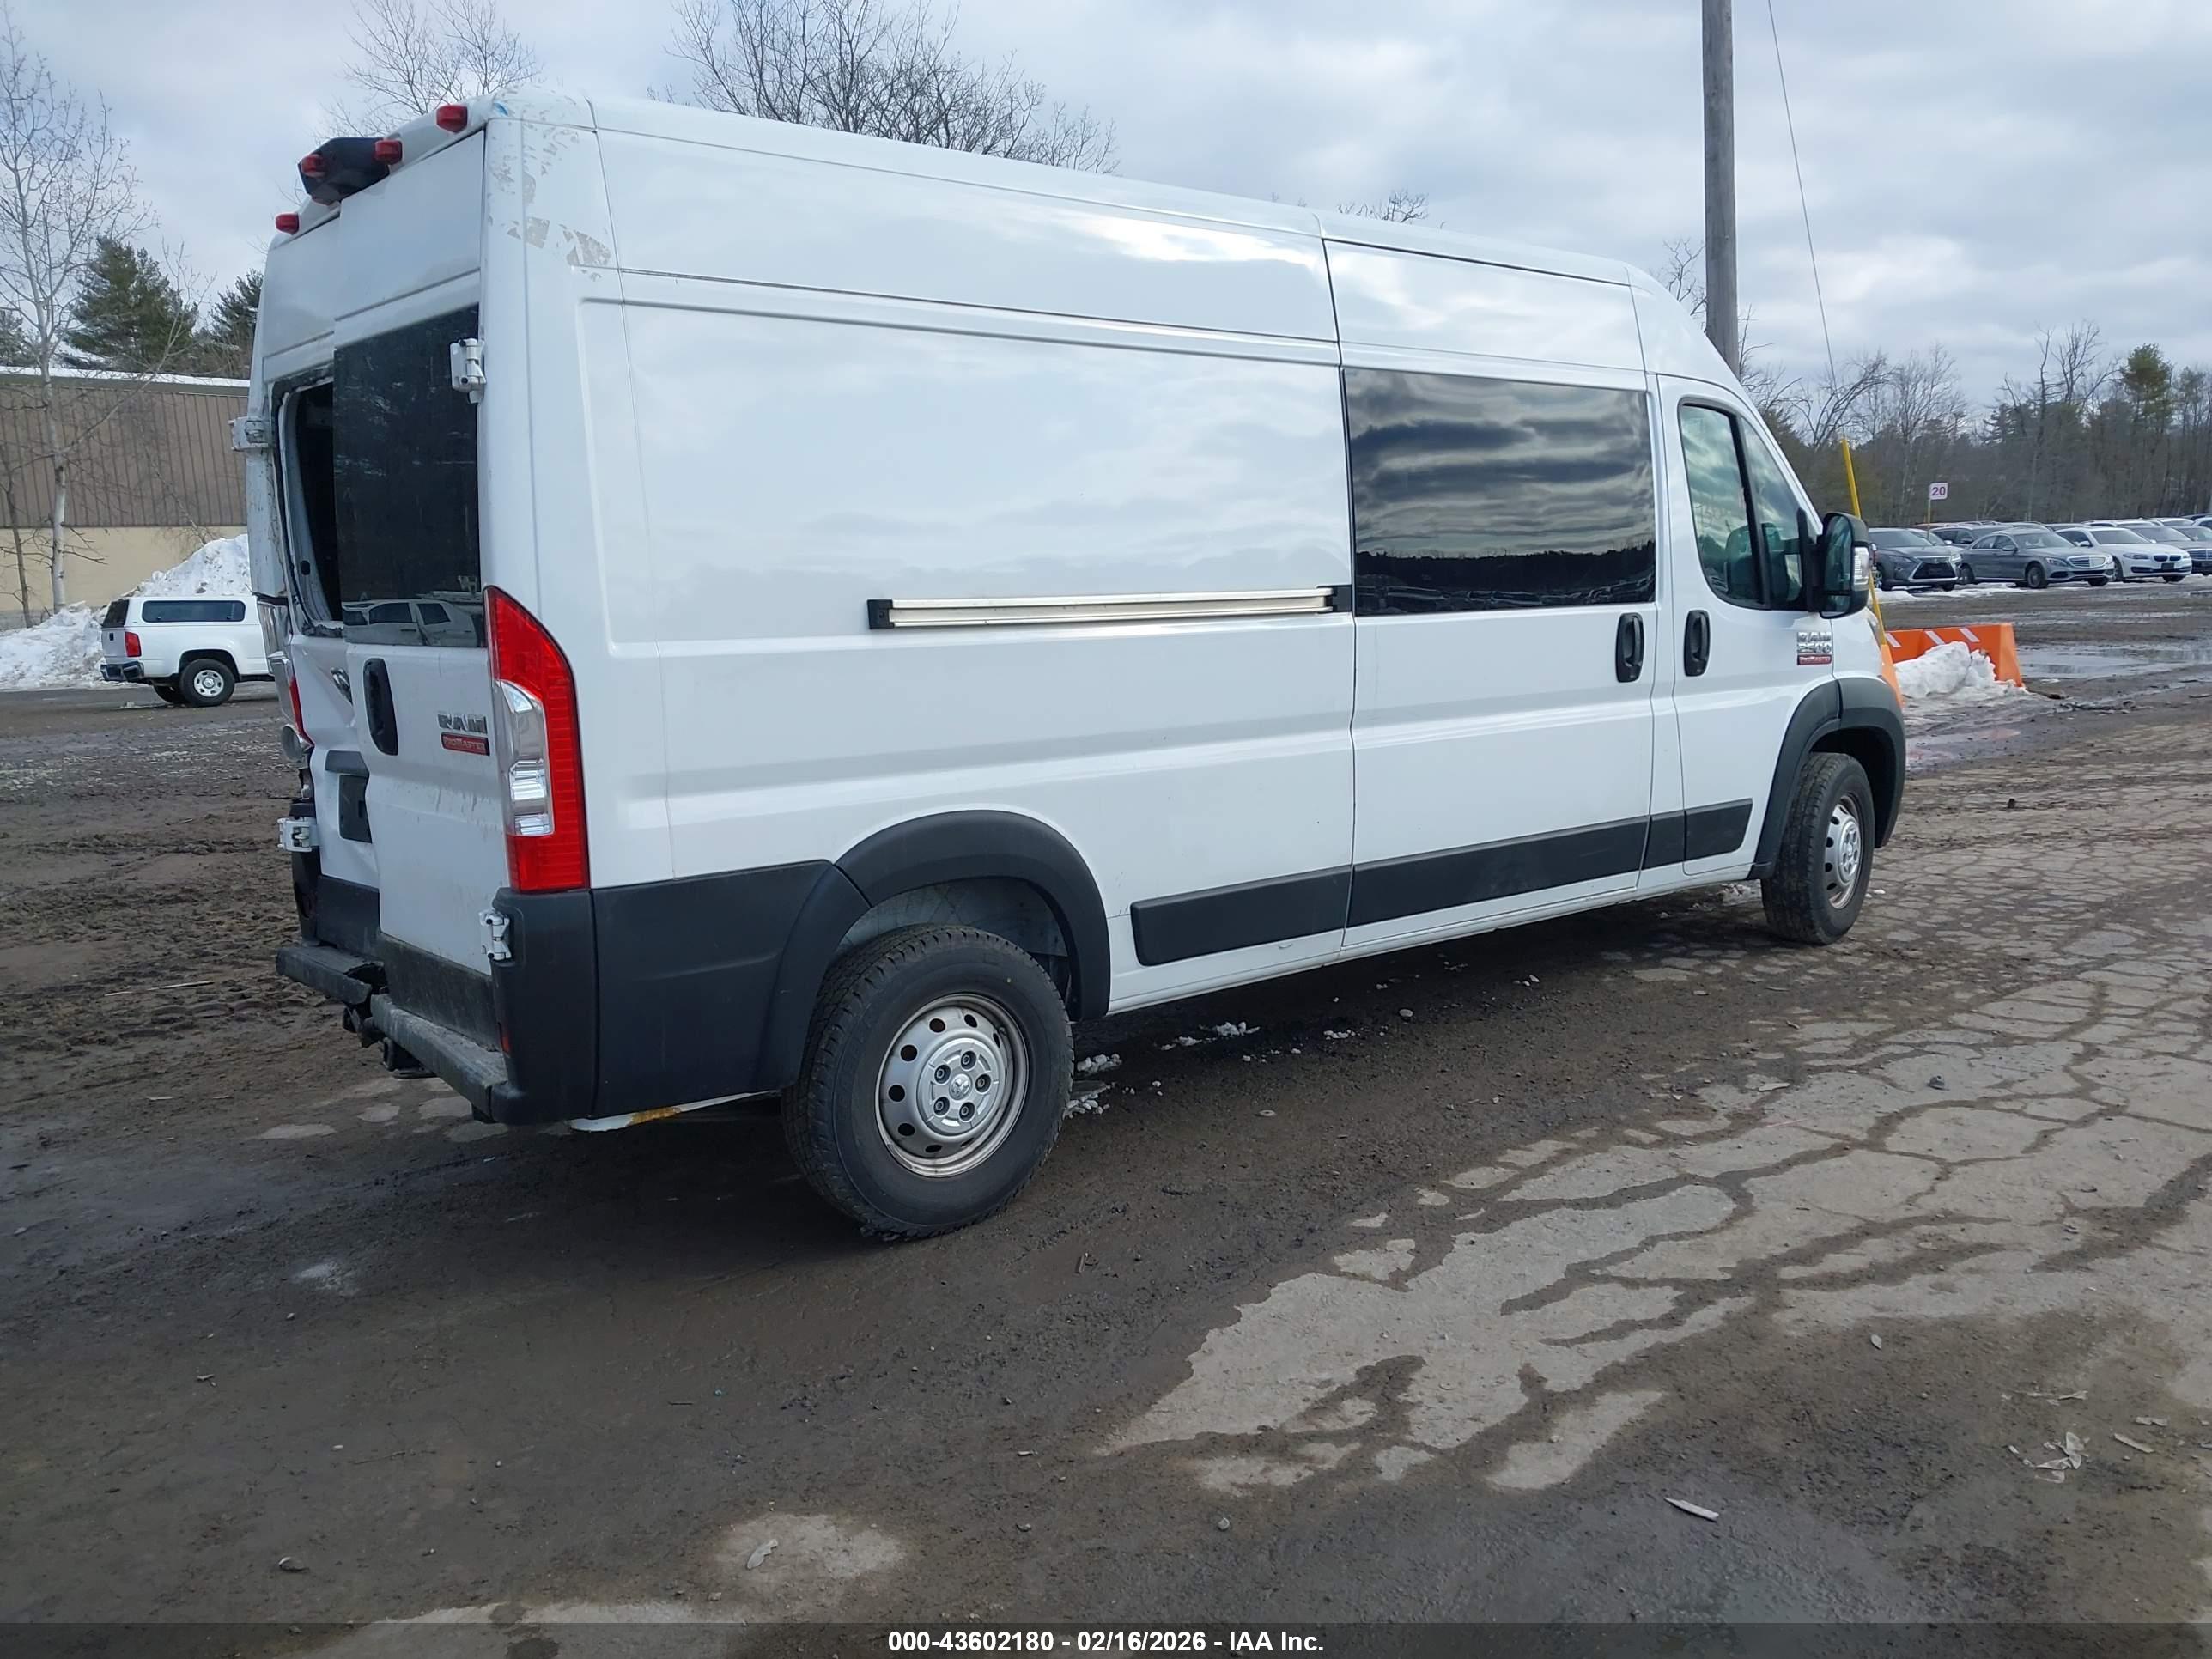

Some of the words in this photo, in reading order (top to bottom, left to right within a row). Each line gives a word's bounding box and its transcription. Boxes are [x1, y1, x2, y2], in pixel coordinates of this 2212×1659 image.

[1932, 486, 1946, 496] 20
[1796, 631, 1832, 642] RAM
[437, 714, 488, 735] RAM
